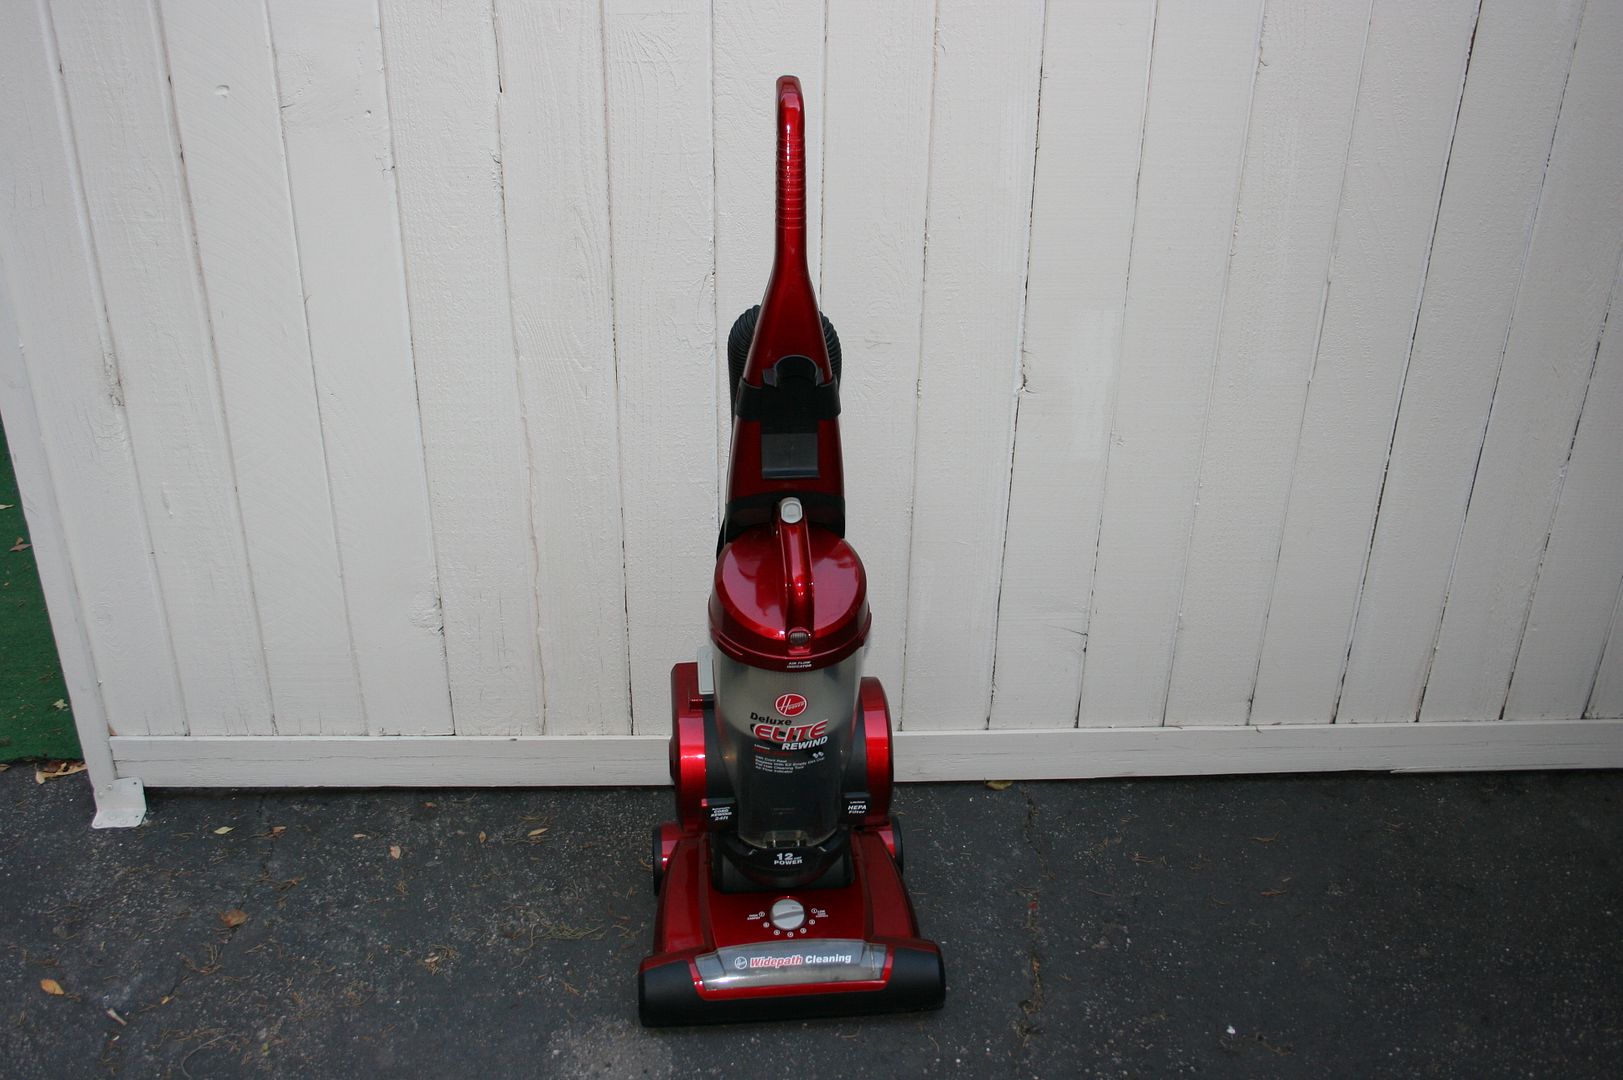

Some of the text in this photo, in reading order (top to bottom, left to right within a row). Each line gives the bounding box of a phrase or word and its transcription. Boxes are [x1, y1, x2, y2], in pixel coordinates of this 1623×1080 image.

[750, 712, 792, 726] Deluxe
[753, 719, 829, 743] ELITE
[781, 735, 829, 751] REWIND
[777, 852, 794, 861] 12
[749, 954, 803, 969] Widepath
[805, 953, 852, 964] Cleaning
